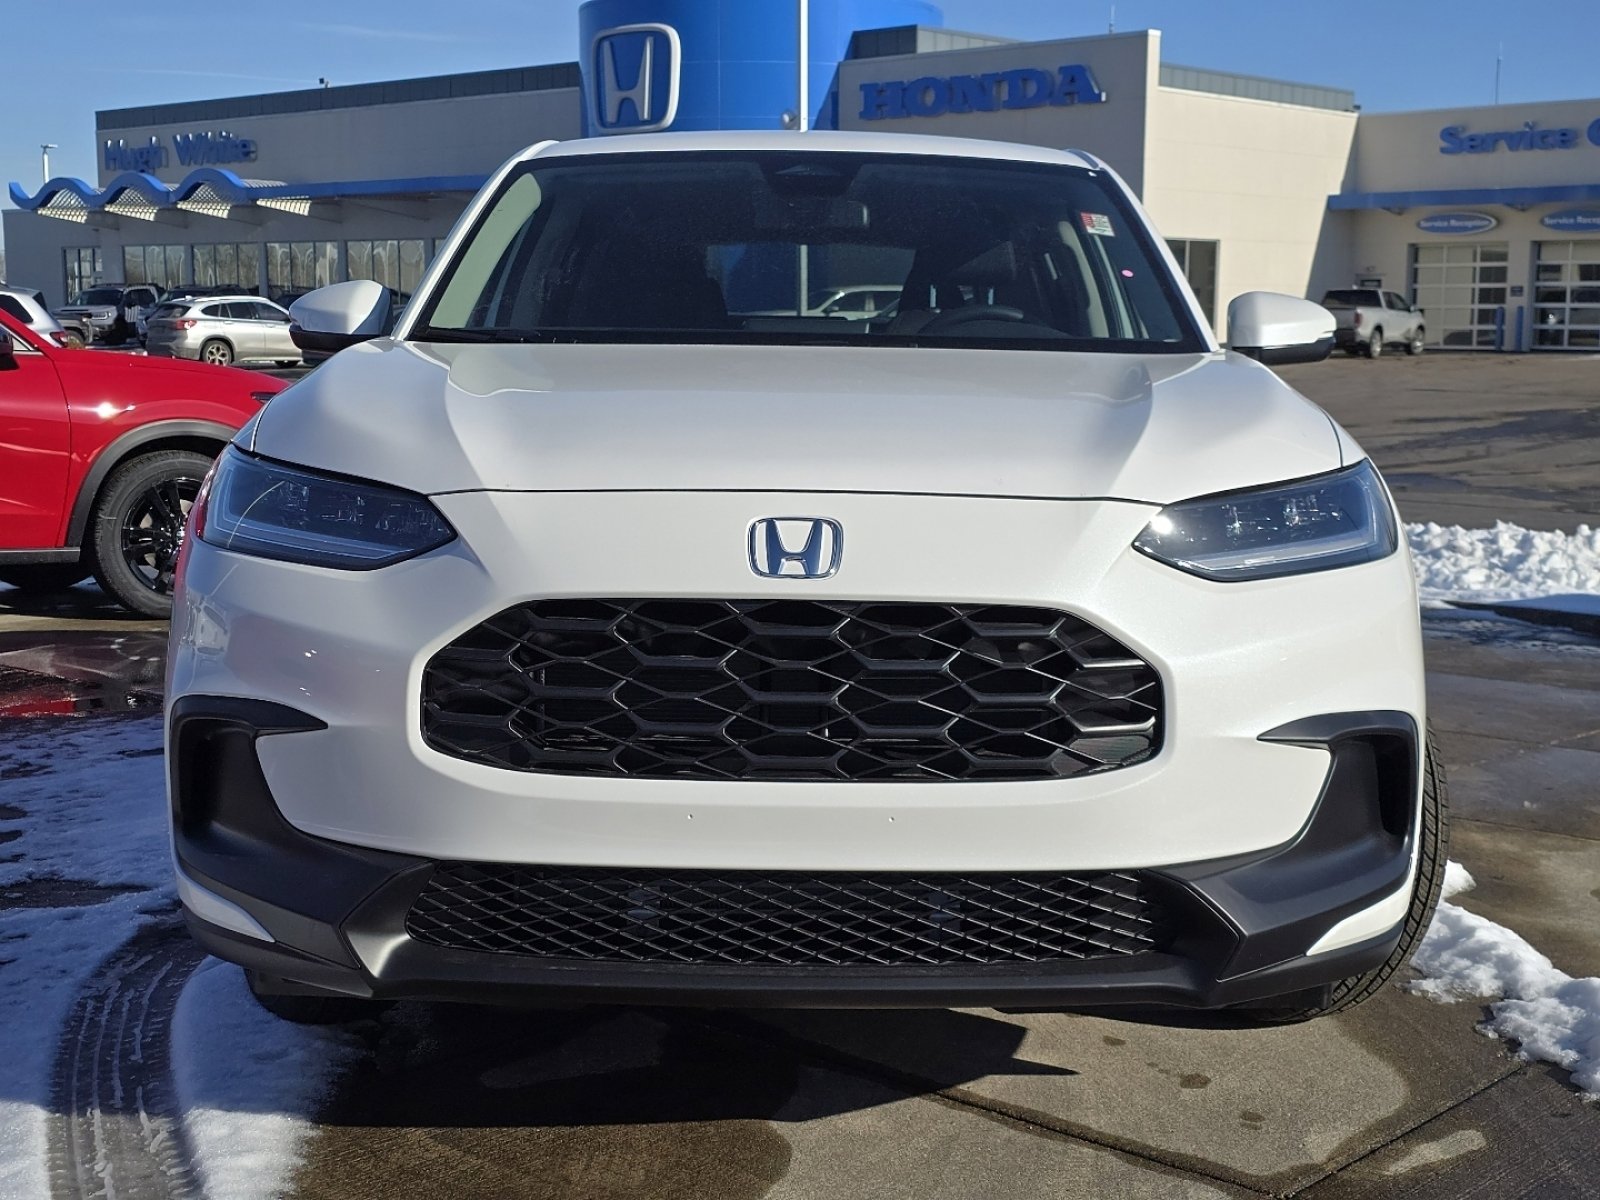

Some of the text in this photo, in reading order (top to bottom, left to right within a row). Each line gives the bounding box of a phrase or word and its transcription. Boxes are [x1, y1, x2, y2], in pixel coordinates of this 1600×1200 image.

[859, 64, 1106, 120] HONDA
[104, 131, 257, 173] Hugh White
[1439, 120, 1578, 154] Service
[1420, 219, 1448, 228] Service
[1543, 216, 1574, 225] Service
